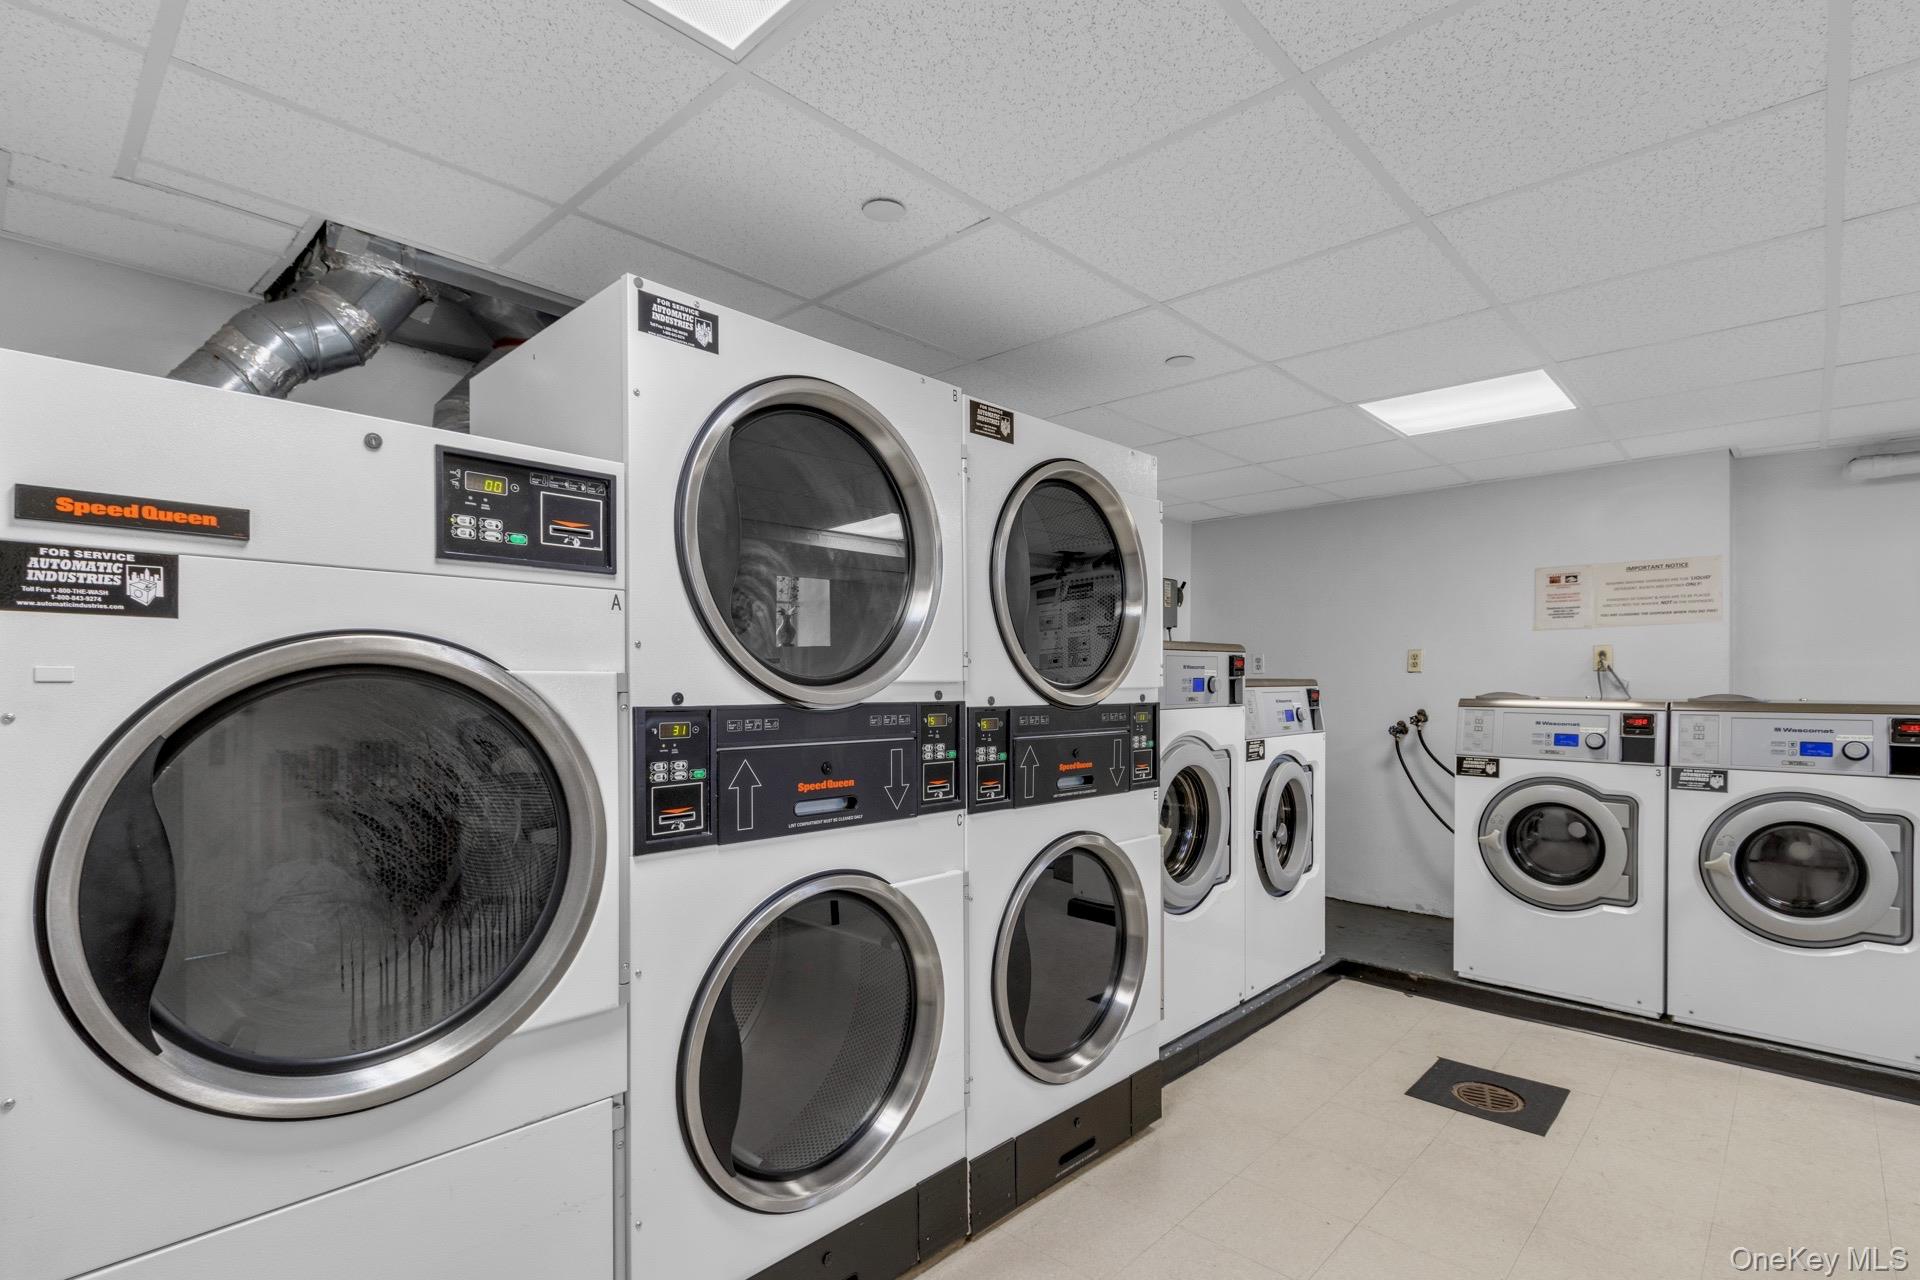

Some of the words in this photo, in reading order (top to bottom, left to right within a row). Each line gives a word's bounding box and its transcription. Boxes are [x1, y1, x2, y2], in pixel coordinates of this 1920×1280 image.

[652, 304, 694, 323] AUTOMATIC
[656, 298, 671, 308] FOR
[672, 302, 700, 316] SERVICE
[652, 312, 694, 330] INDUSTRIES
[952, 389, 958, 402] B
[484, 480, 502, 493] 00
[56, 496, 140, 519] Speed
[141, 506, 218, 527] Queen
[40, 547, 70, 557] FOR
[73, 550, 136, 562] SERVICE
[27, 557, 123, 574] AUTOMATIC
[26, 569, 122, 586] INDUSTRIES
[52, 587, 109, 596] 1-800-THE-WASH
[16, 600, 124, 610] www.automaticindustries.com
[611, 594, 621, 610] A
[672, 726, 686, 736] 31
[1656, 769, 1661, 777] 3
[798, 780, 827, 793] Speed
[827, 779, 855, 788] Queen
[1154, 790, 1158, 800] E
[957, 814, 962, 826] C
